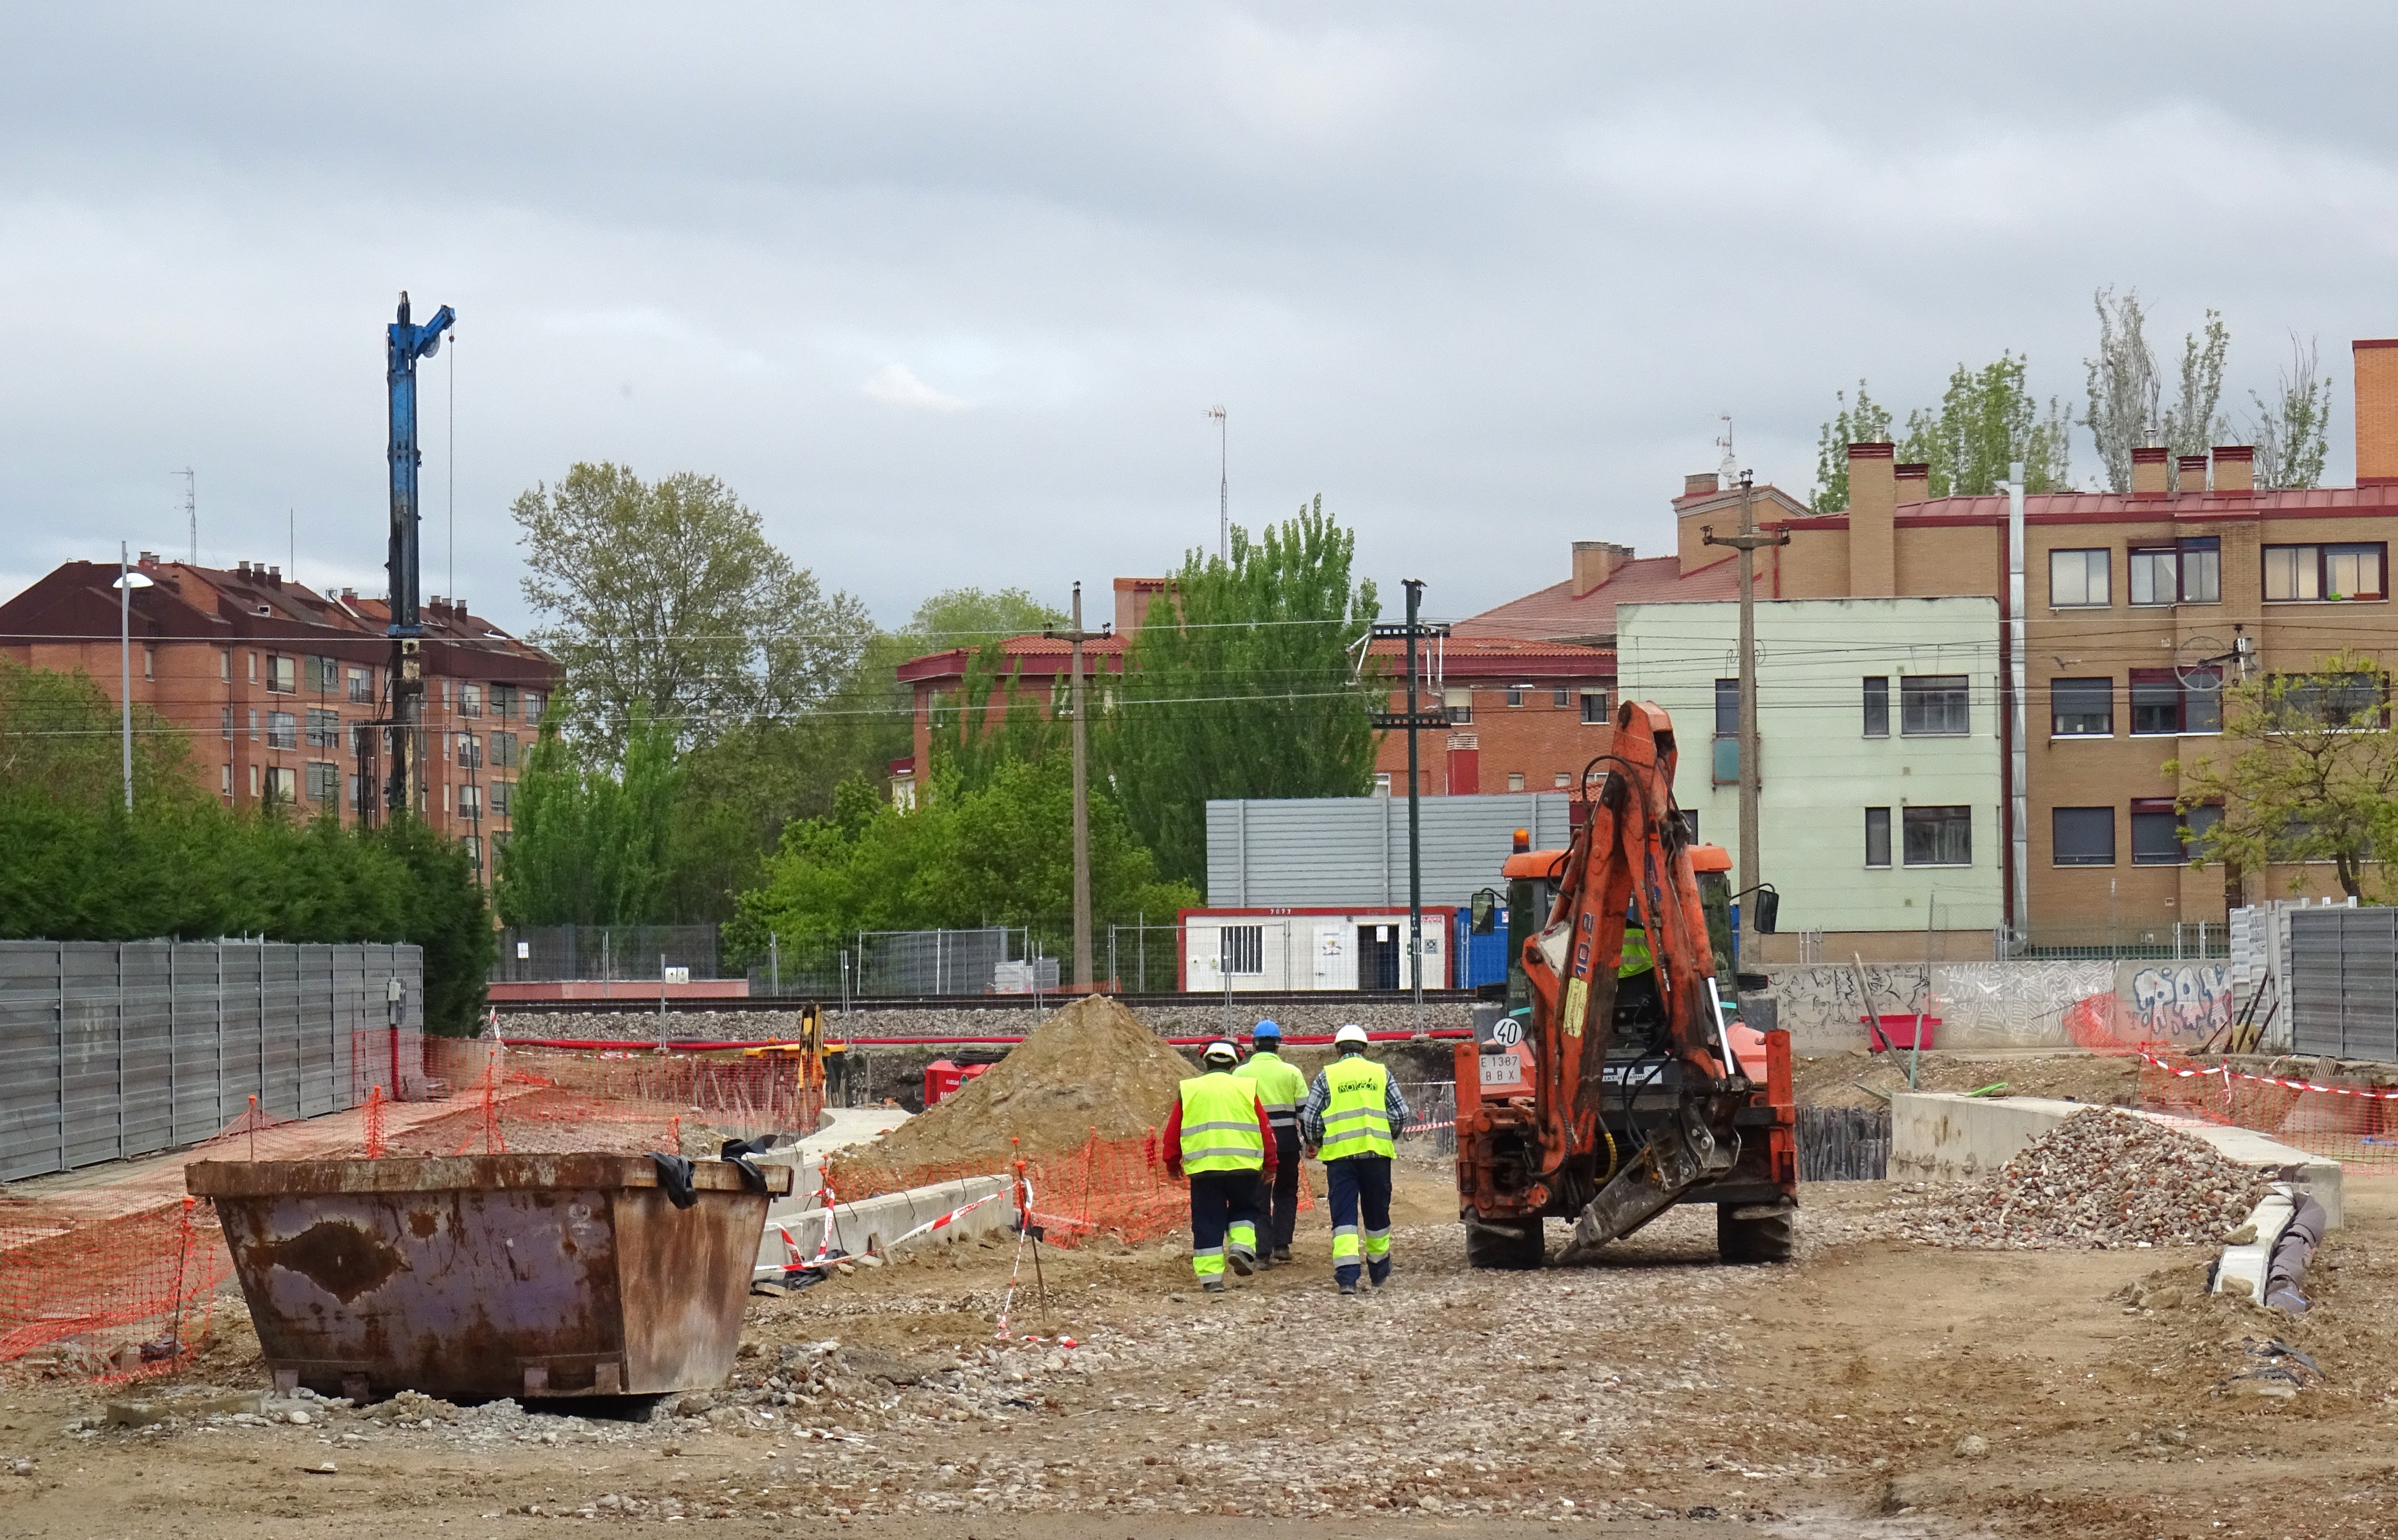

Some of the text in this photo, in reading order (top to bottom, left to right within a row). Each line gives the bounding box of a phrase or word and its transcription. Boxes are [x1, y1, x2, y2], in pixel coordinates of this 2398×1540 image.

[1497, 1022, 1517, 1044] 40
[1481, 1056, 1518, 1067] E 1387
